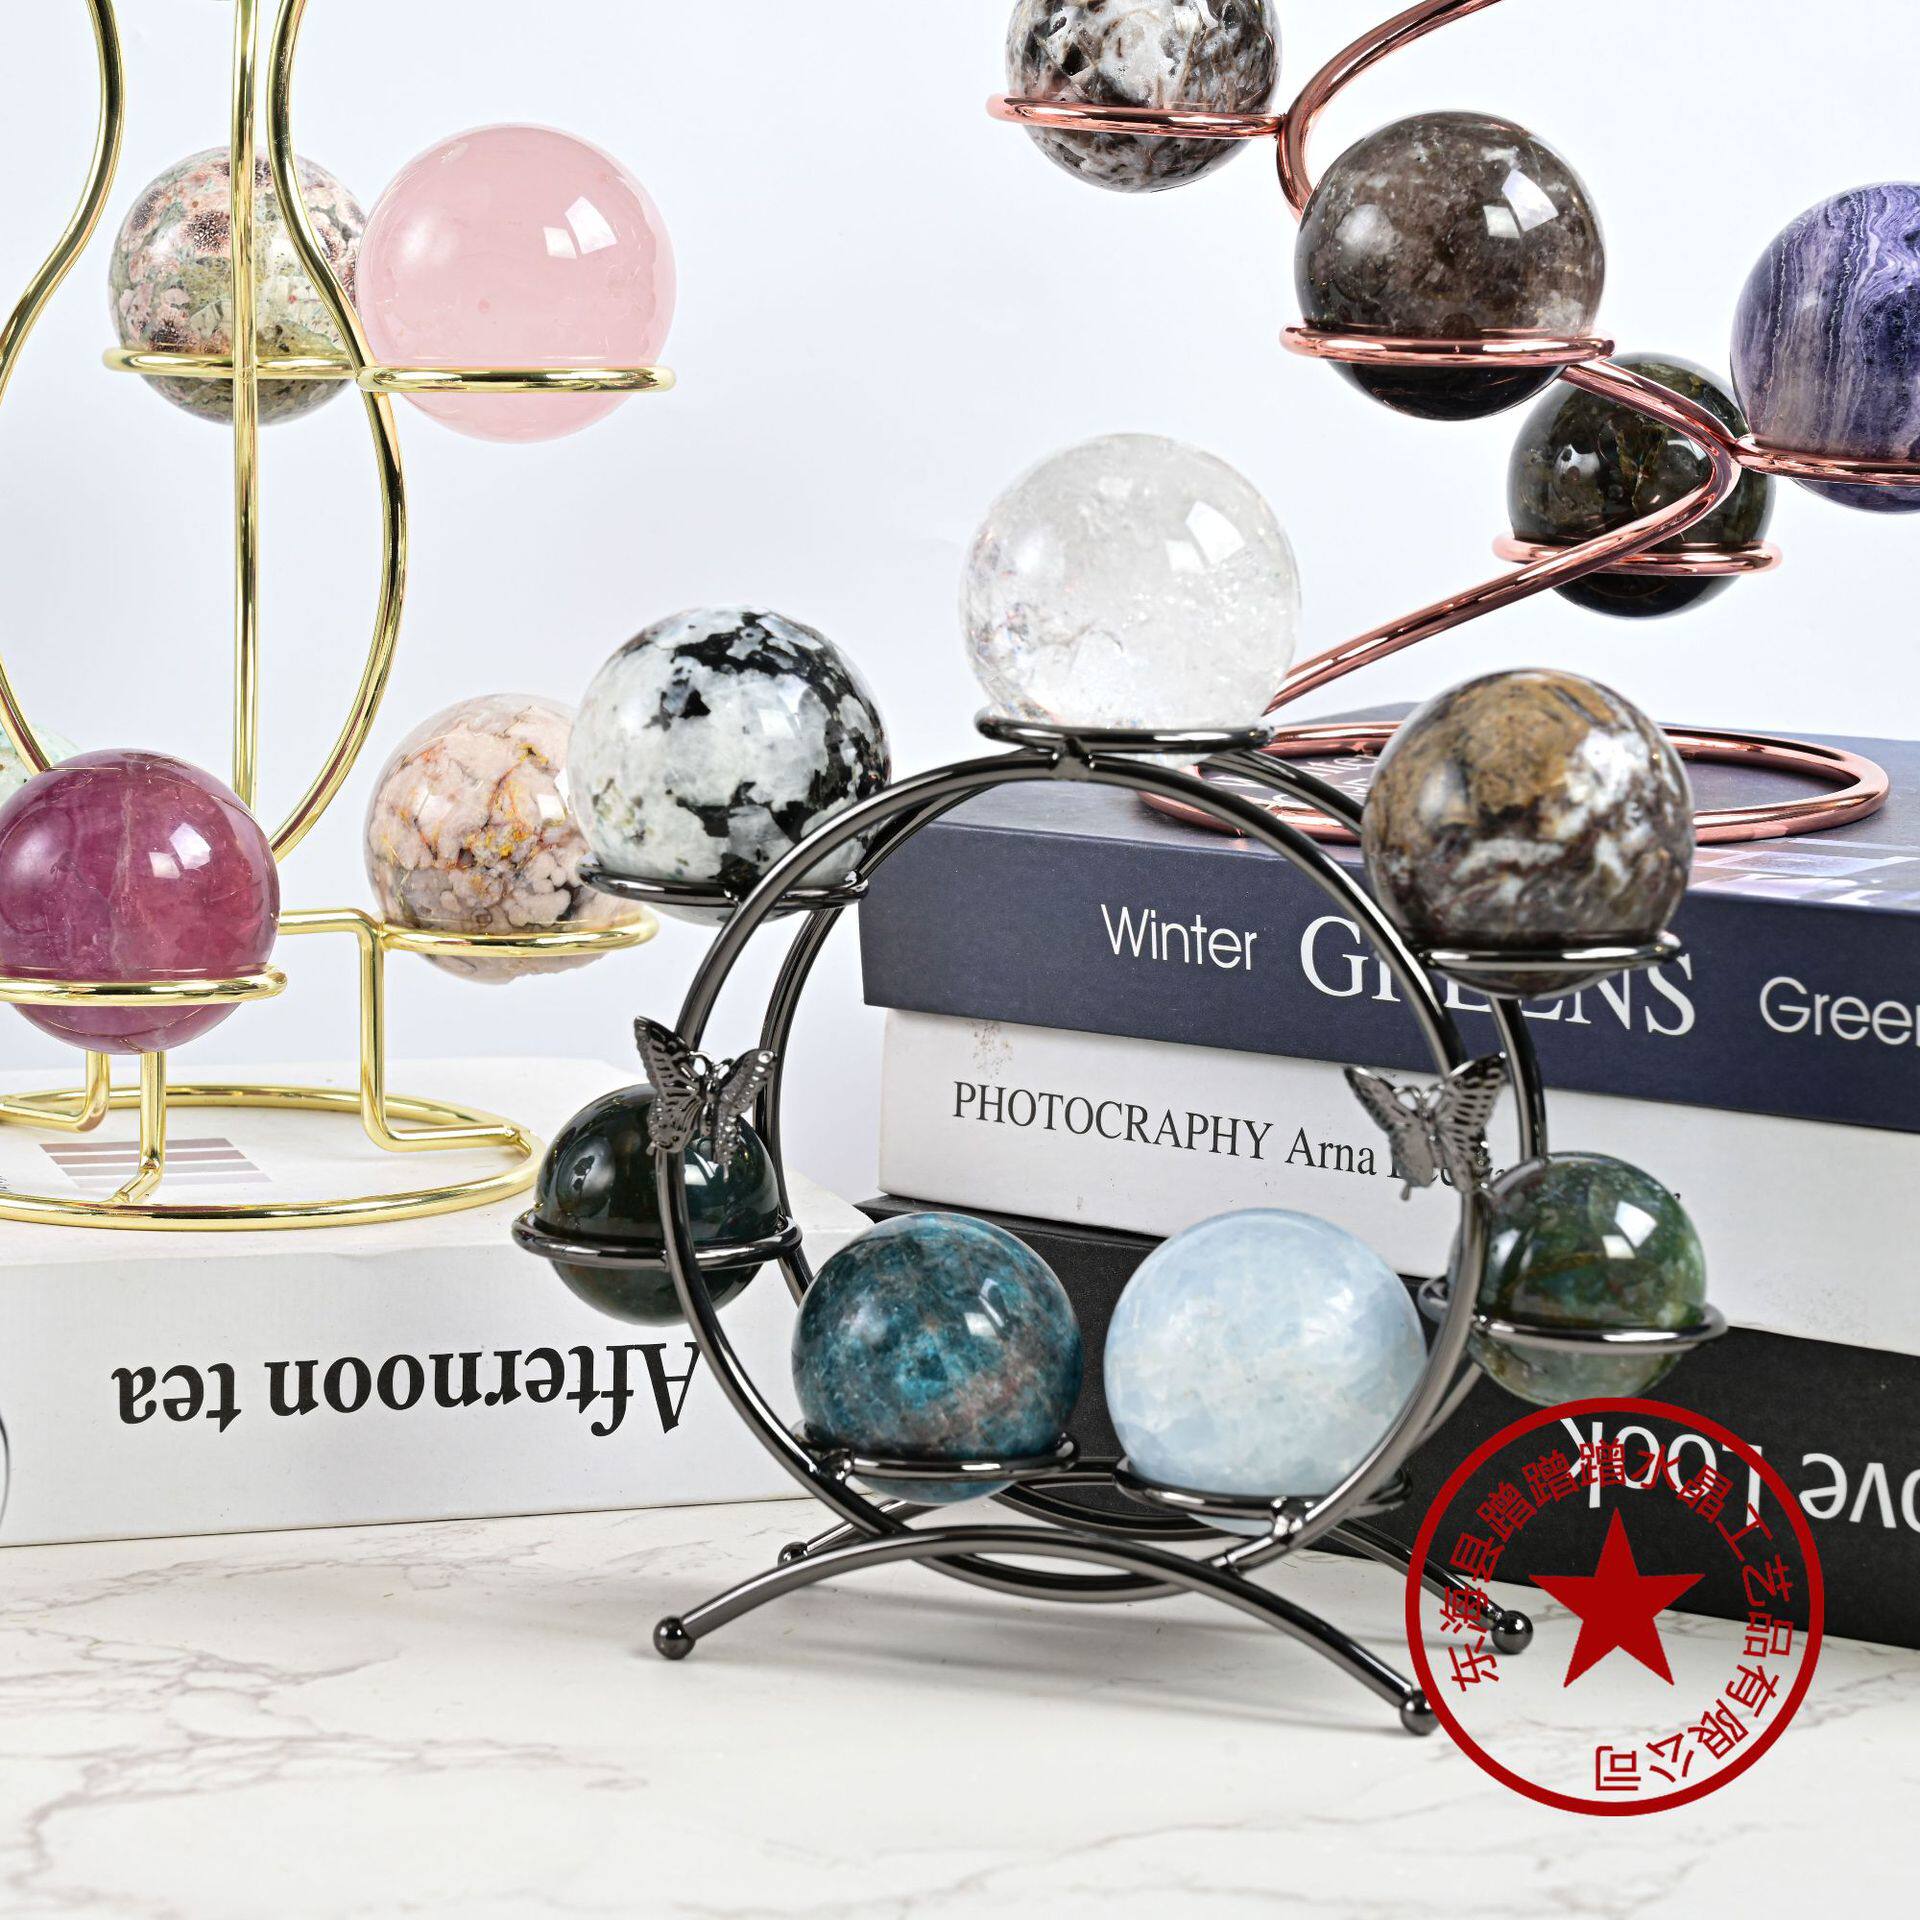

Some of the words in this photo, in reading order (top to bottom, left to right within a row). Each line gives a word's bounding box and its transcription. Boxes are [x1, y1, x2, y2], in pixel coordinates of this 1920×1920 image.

[1101, 904, 1257, 971] Winter
[1300, 915, 1695, 1036] GNS
[1759, 976, 1920, 1047] Gree
[953, 1081, 1274, 1160] PHOTOCRAPHY
[1284, 1127, 1376, 1176] Arna
[111, 1362, 241, 1433] tea
[264, 1341, 701, 1437] Afternoon
[1560, 1417, 1762, 1528] Look
